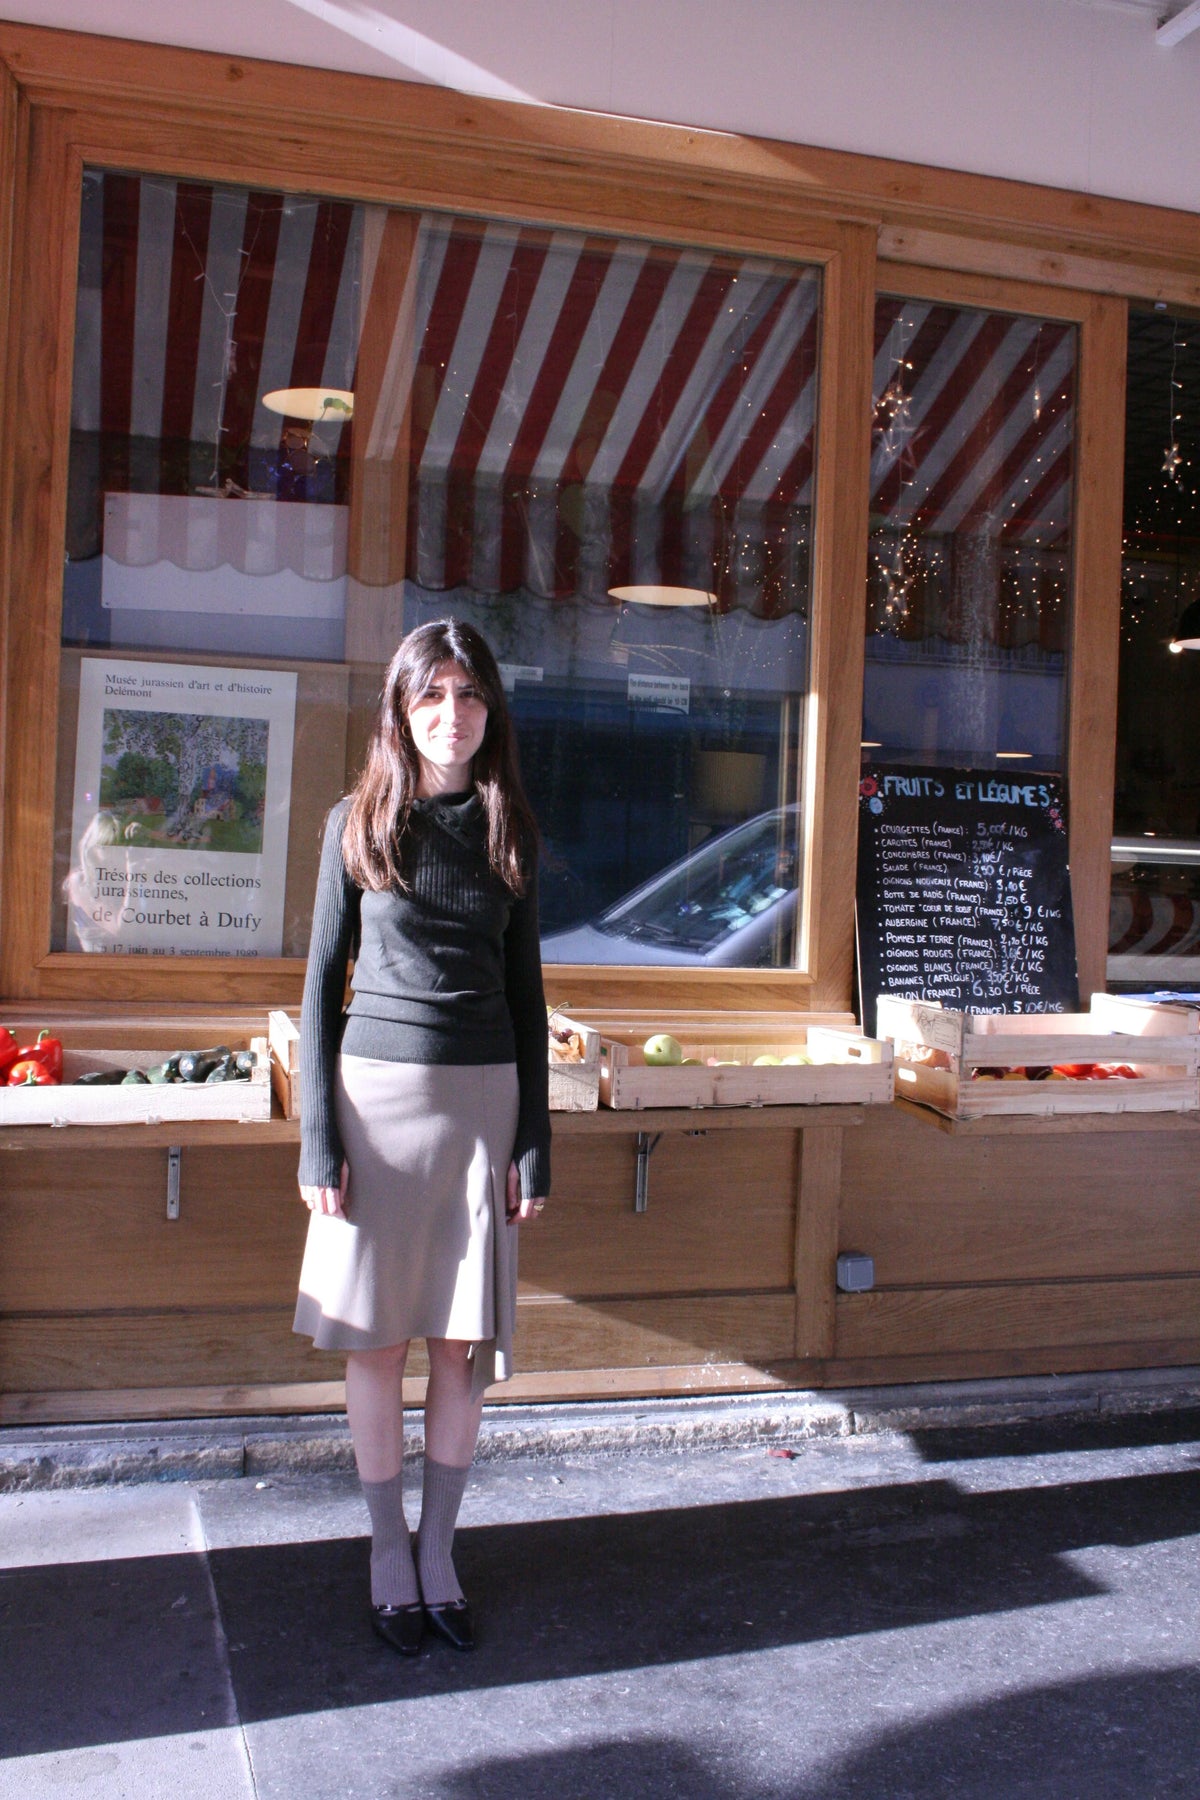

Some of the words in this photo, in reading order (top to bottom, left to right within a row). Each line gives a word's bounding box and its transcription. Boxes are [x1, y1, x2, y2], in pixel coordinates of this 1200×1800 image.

[105, 674, 137, 685] Musée
[142, 677, 184, 689] jurassien
[188, 680, 210, 691] d'art
[214, 683, 223, 692] et
[227, 683, 272, 695] d'histoire
[105, 685, 152, 698] Delémont
[884, 776, 945, 797] FRUITS
[955, 782, 975, 800] ET
[978, 779, 1051, 808] LÉGUMES
[881, 824, 931, 835] COURGETTES
[881, 839, 918, 848] CAROTTES
[922, 837, 952, 849] (FRANCE)
[882, 851, 931, 860] CONCOMBRES
[882, 863, 909, 873] SALADE
[96, 867, 147, 883] Trésors
[153, 870, 177, 885] des
[184, 872, 262, 889] collections
[916, 878, 952, 887] NOUVEAUX
[884, 890, 905, 899] BOTTE
[883, 904, 915, 913] TOMATE
[944, 905, 953, 913] DE
[92, 907, 113, 922] de
[121, 908, 191, 926] Courbet
[199, 911, 209, 927] à
[217, 911, 262, 932] Dufy
[886, 932, 915, 943] POMMES
[917, 935, 927, 943] DE
[930, 935, 954, 945] TERRE
[152, 947, 165, 955] au
[168, 946, 175, 955] 3
[923, 950, 954, 959] ROUGES
[923, 962, 952, 973] BLANCS
[888, 976, 924, 987] BANANES
